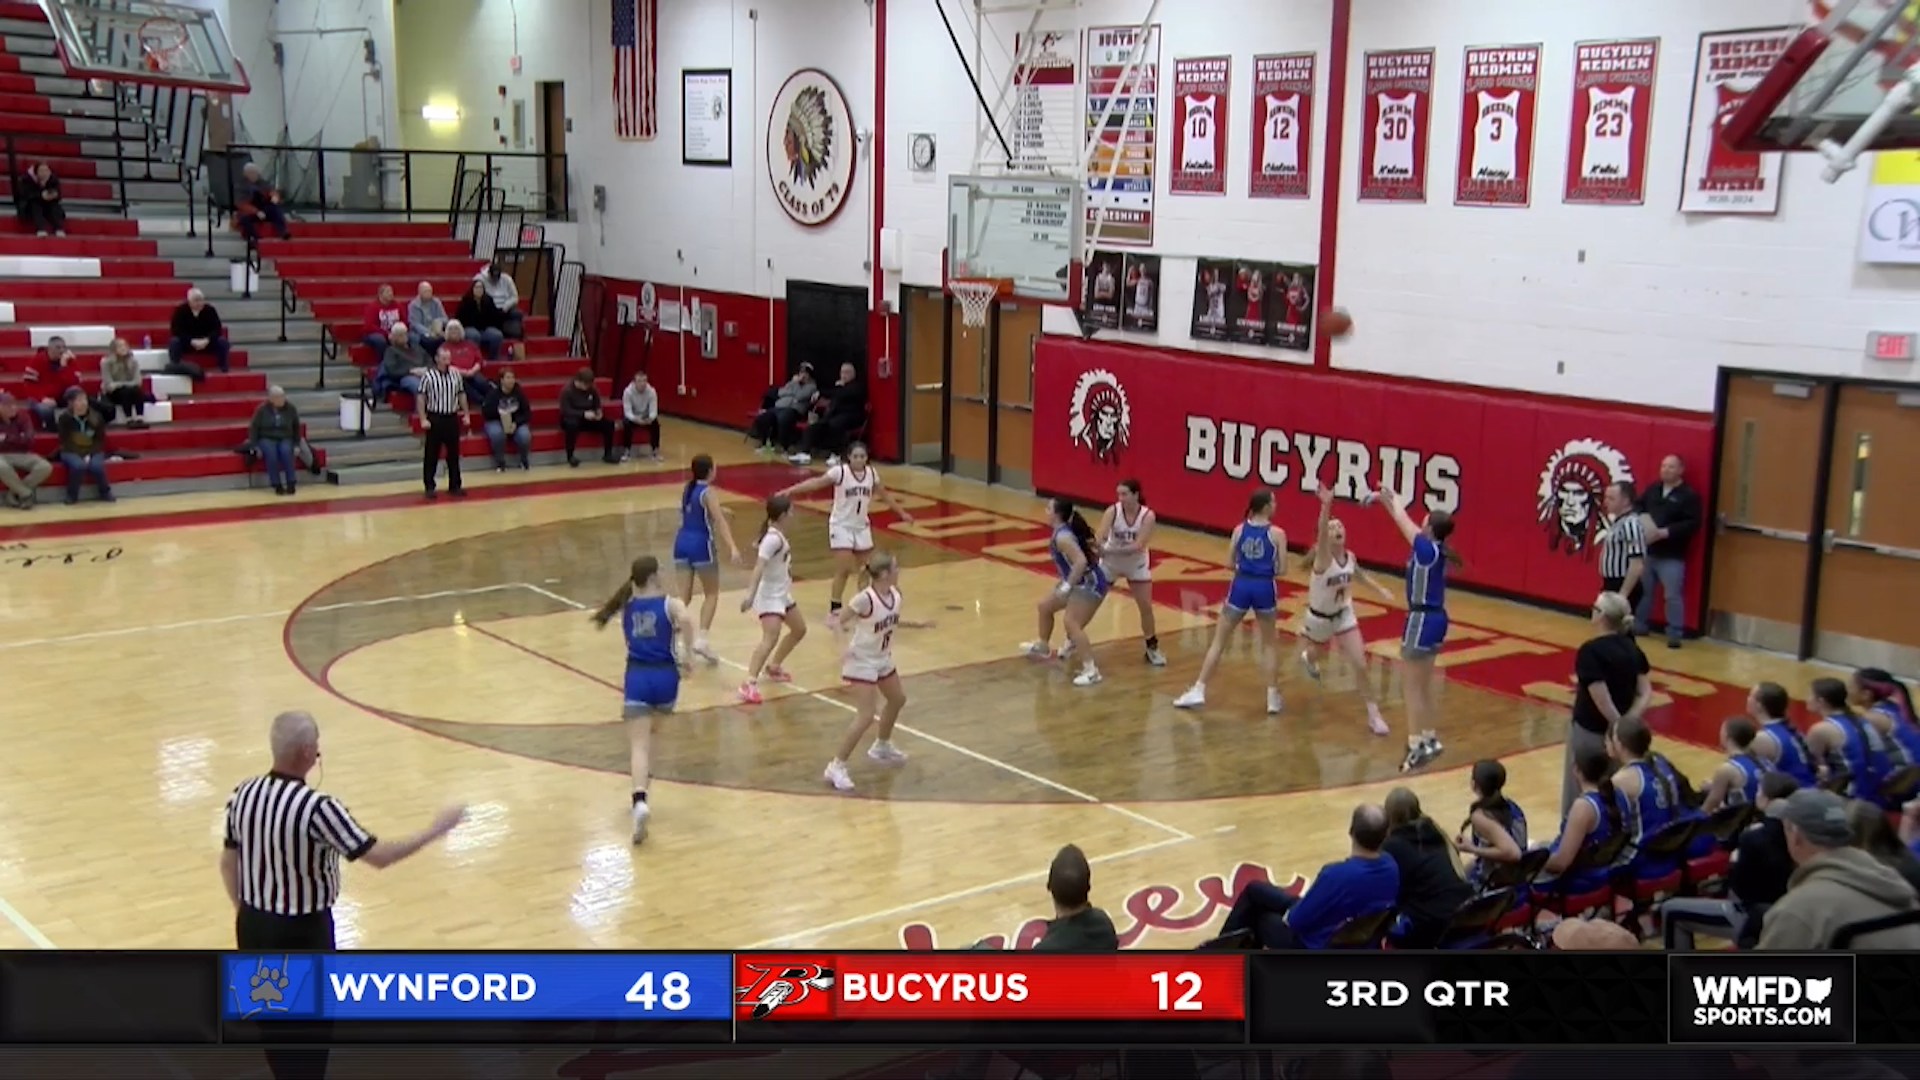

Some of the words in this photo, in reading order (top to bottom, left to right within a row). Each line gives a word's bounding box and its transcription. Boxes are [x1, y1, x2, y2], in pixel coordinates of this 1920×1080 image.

[1468, 50, 1536, 64] BUCYRUS
[1580, 45, 1653, 59] BUCYRUS
[1177, 60, 1227, 72] BUCYRUS
[1257, 57, 1312, 70] BUCYRUS
[1368, 54, 1431, 67] BUCYRUS
[1580, 58, 1650, 72] REDMEN
[1259, 69, 1310, 82] REDMEN
[1370, 66, 1428, 79] REDMEN
[1469, 63, 1533, 77] REDMEN
[1178, 72, 1225, 83] REDMEN
[1192, 117, 1207, 138] 10
[1273, 118, 1290, 139] 12
[1383, 118, 1407, 140] 30
[1490, 118, 1502, 141] 3
[1595, 113, 1623, 137] 23
[778, 180, 808, 215] CLASS
[811, 200, 825, 216] OF
[1185, 414, 1464, 515] BUCYRUS
